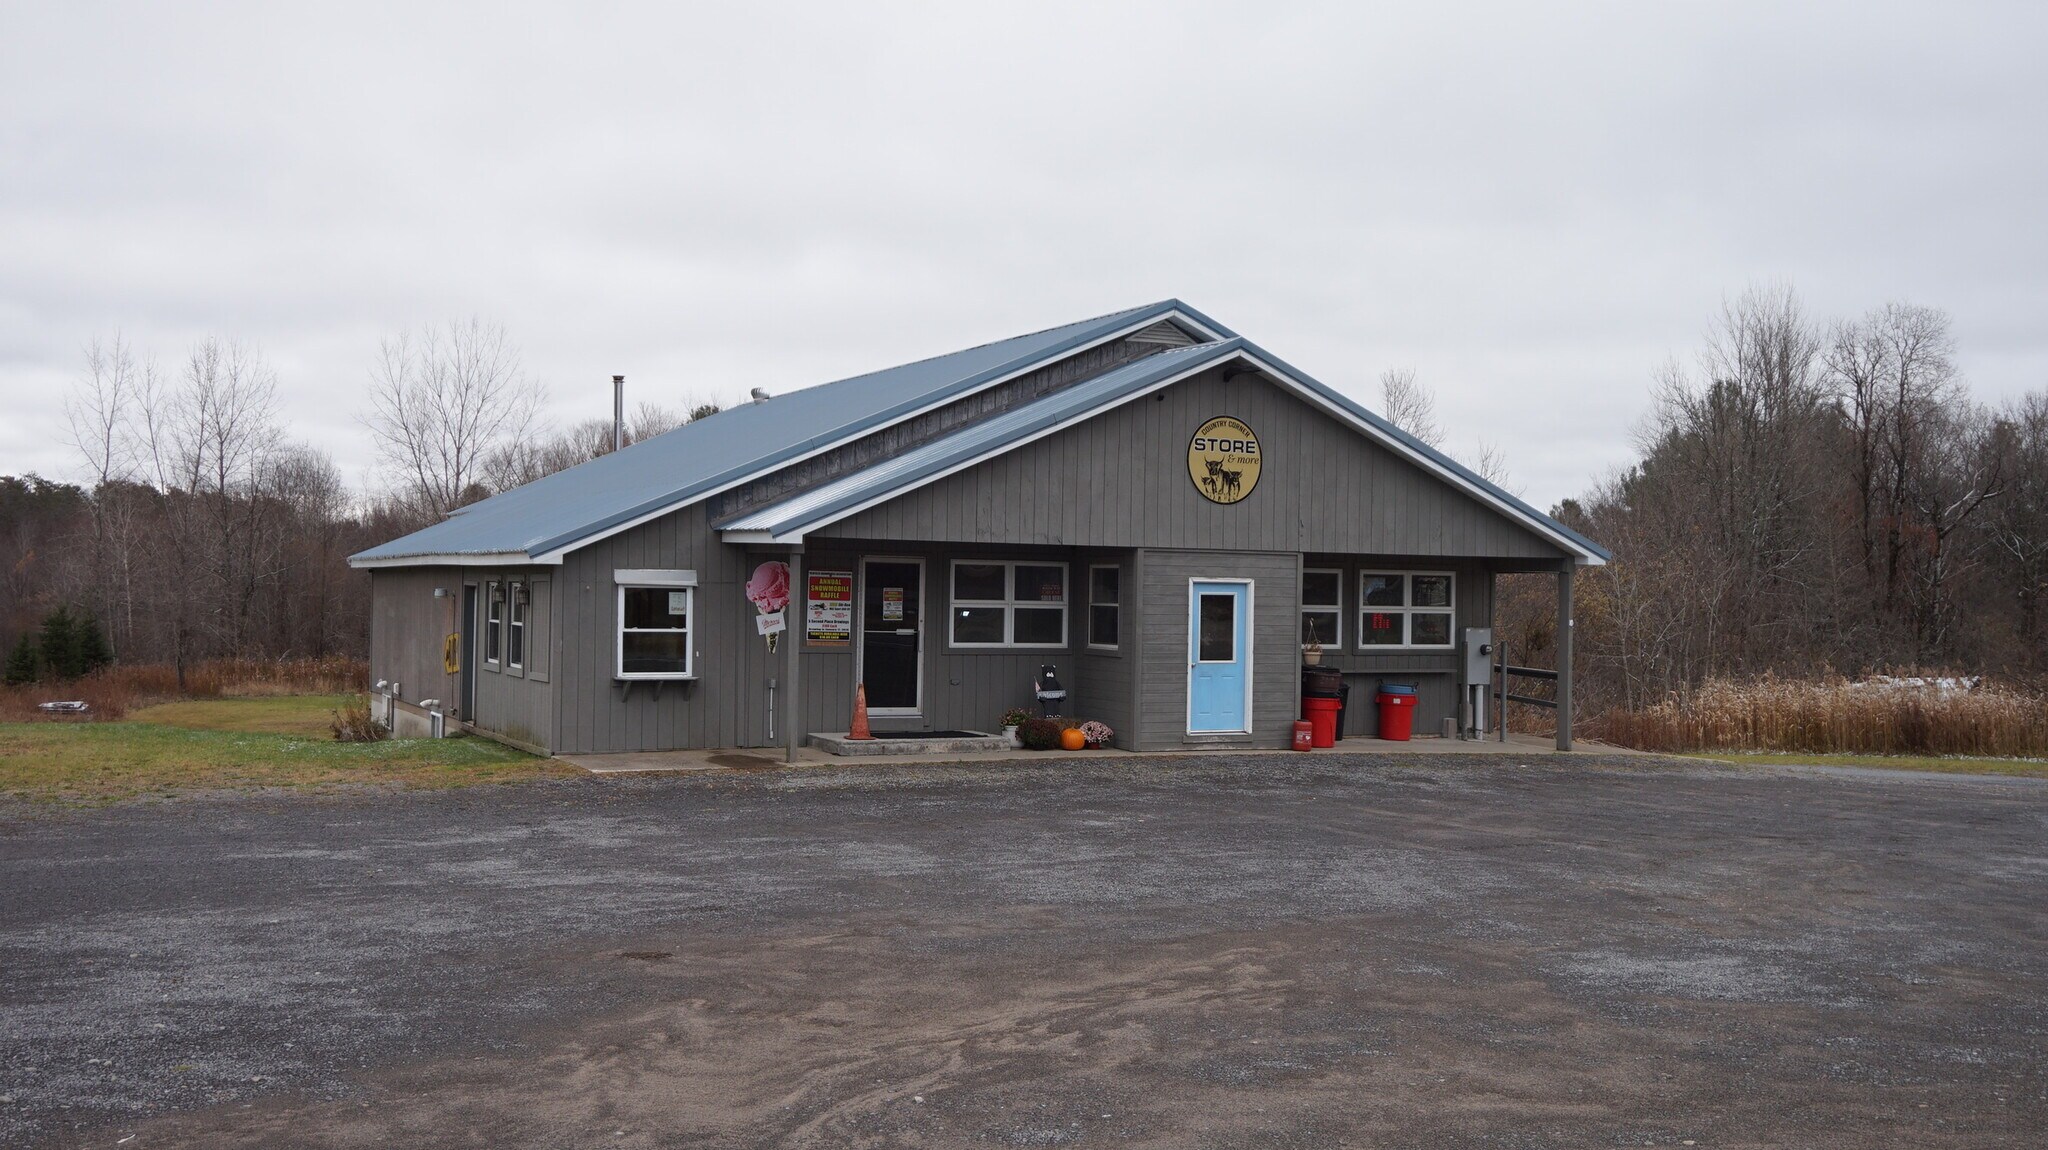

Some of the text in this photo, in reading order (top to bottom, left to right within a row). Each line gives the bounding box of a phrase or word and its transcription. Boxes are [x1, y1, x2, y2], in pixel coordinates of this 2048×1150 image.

[1201, 420, 1251, 437] COUNTRY CORNER
[1194, 438, 1256, 454] STORE
[1227, 454, 1259, 465] & more
